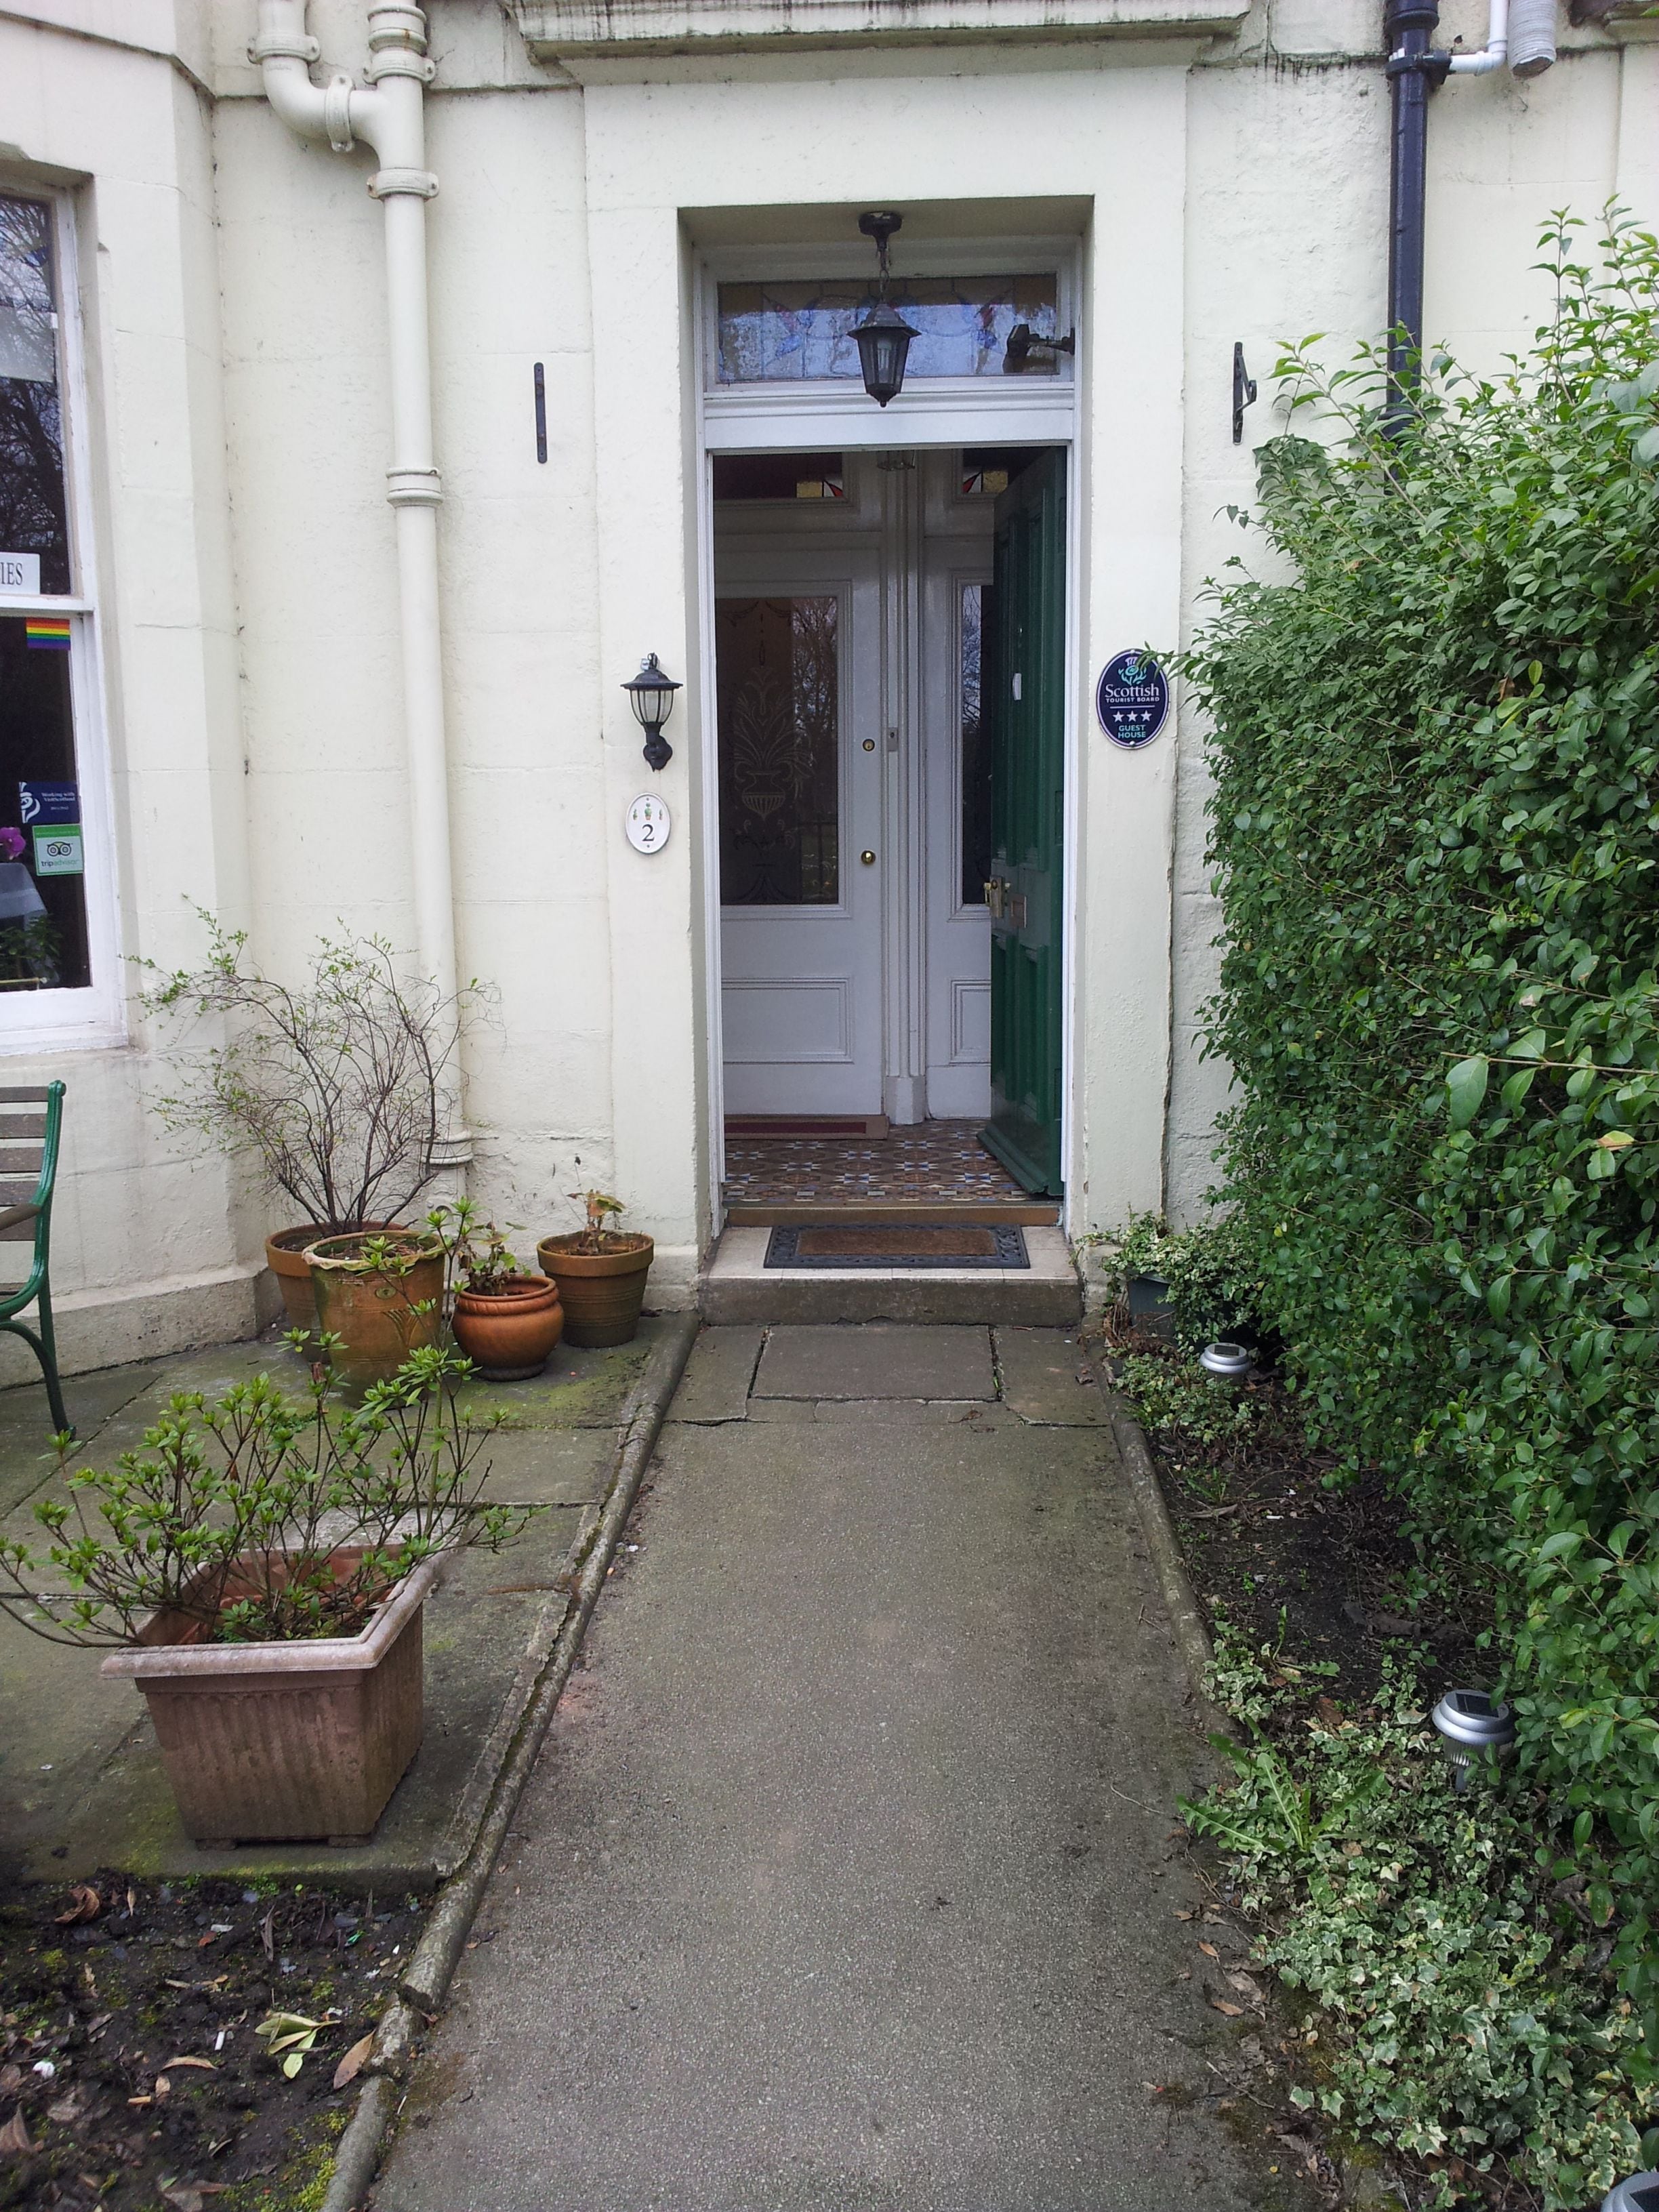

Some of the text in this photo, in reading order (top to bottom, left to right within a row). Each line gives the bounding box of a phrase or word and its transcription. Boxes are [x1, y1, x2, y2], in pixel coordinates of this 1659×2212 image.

[0, 562, 23, 586] IES
[1105, 683, 1160, 698] Scottish
[642, 823, 655, 842] 2
[41, 859, 80, 867] tripadvisor
